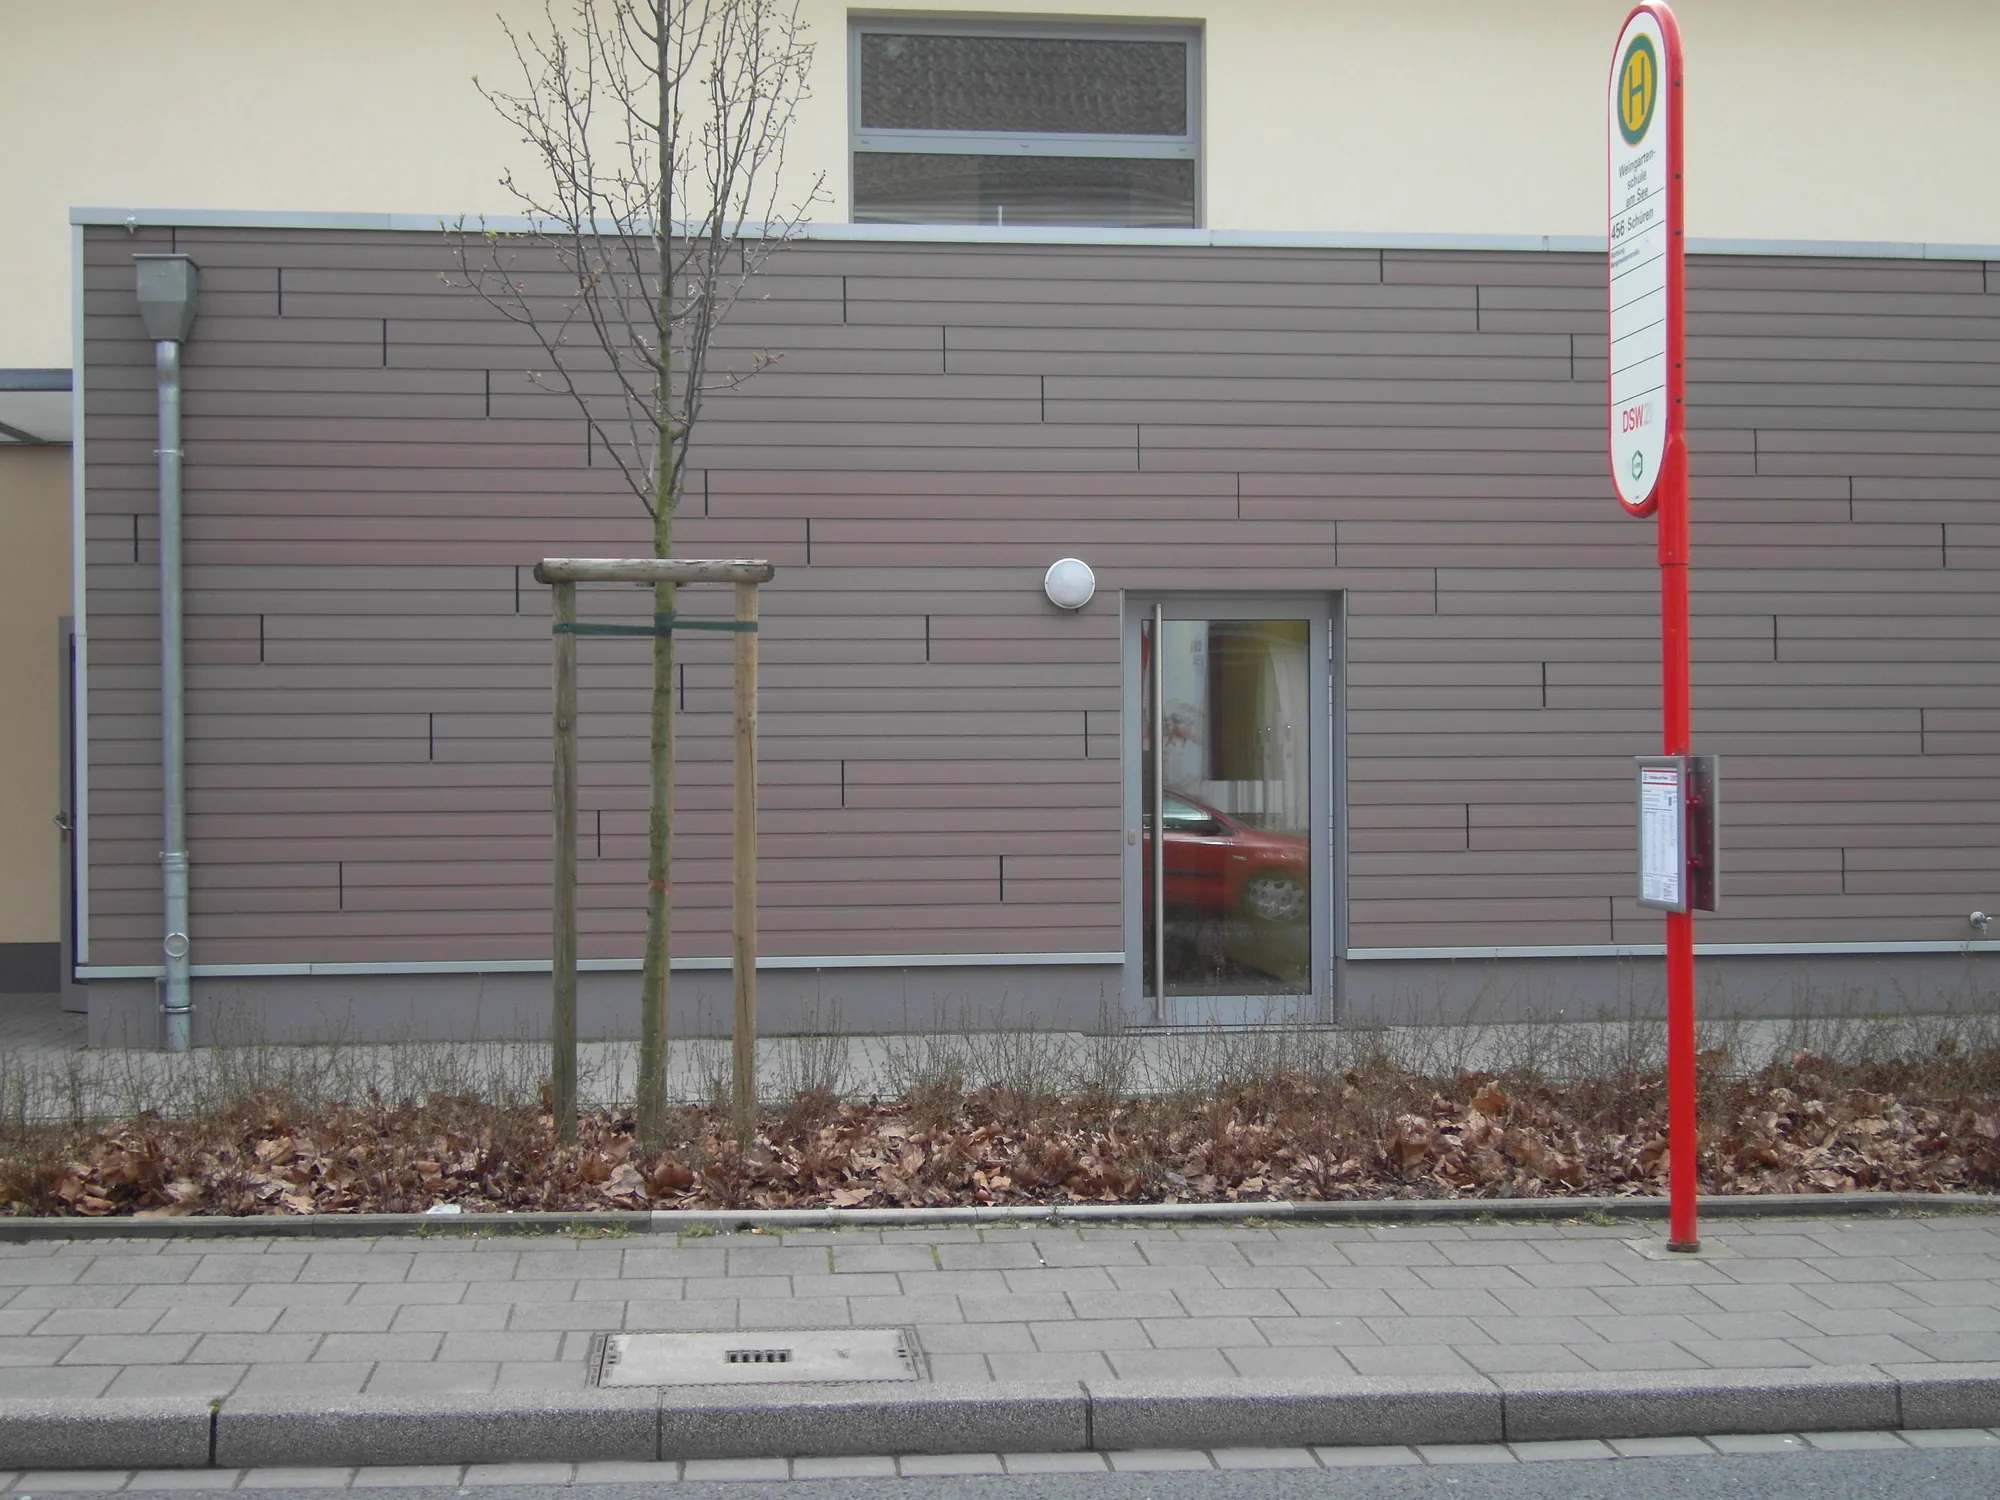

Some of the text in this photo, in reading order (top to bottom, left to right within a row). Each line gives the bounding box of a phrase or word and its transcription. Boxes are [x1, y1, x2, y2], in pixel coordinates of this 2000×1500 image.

[1628, 56, 1645, 123] H
[1618, 149, 1656, 178] Weingarten-
[1627, 169, 1647, 190] schule
[1625, 187, 1649, 208] am See
[1611, 208, 1654, 240] 456 Schüren
